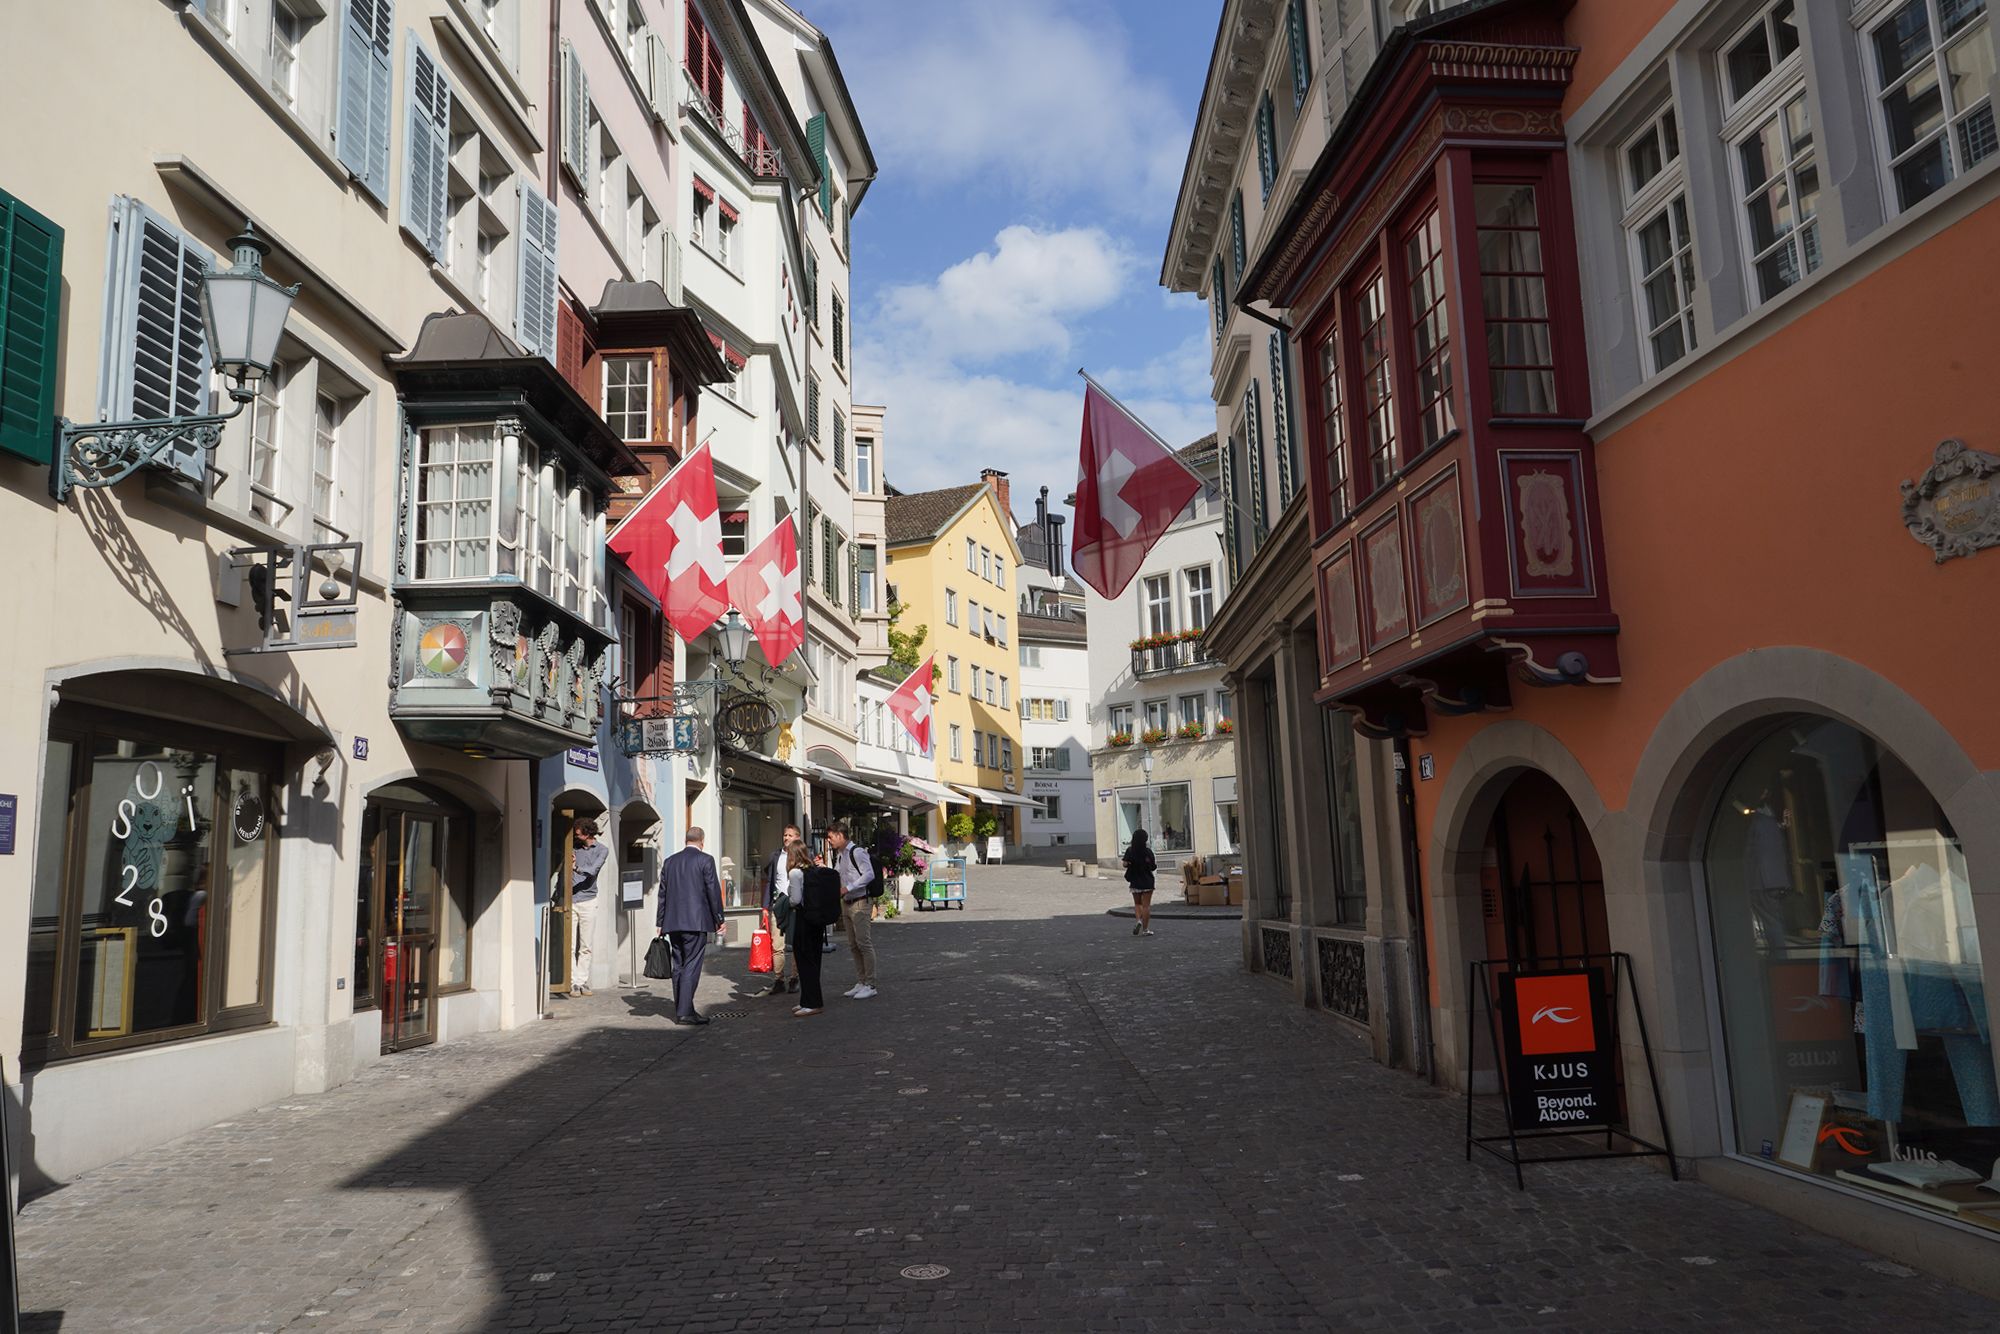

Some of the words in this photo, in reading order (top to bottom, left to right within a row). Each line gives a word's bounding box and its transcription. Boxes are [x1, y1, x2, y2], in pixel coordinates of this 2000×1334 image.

[1534, 1062, 1588, 1080] KJUS
[1537, 1093, 1596, 1111] Beyond.
[1539, 1109, 1590, 1122] Above.
[1890, 1143, 1938, 1166] KJUS
